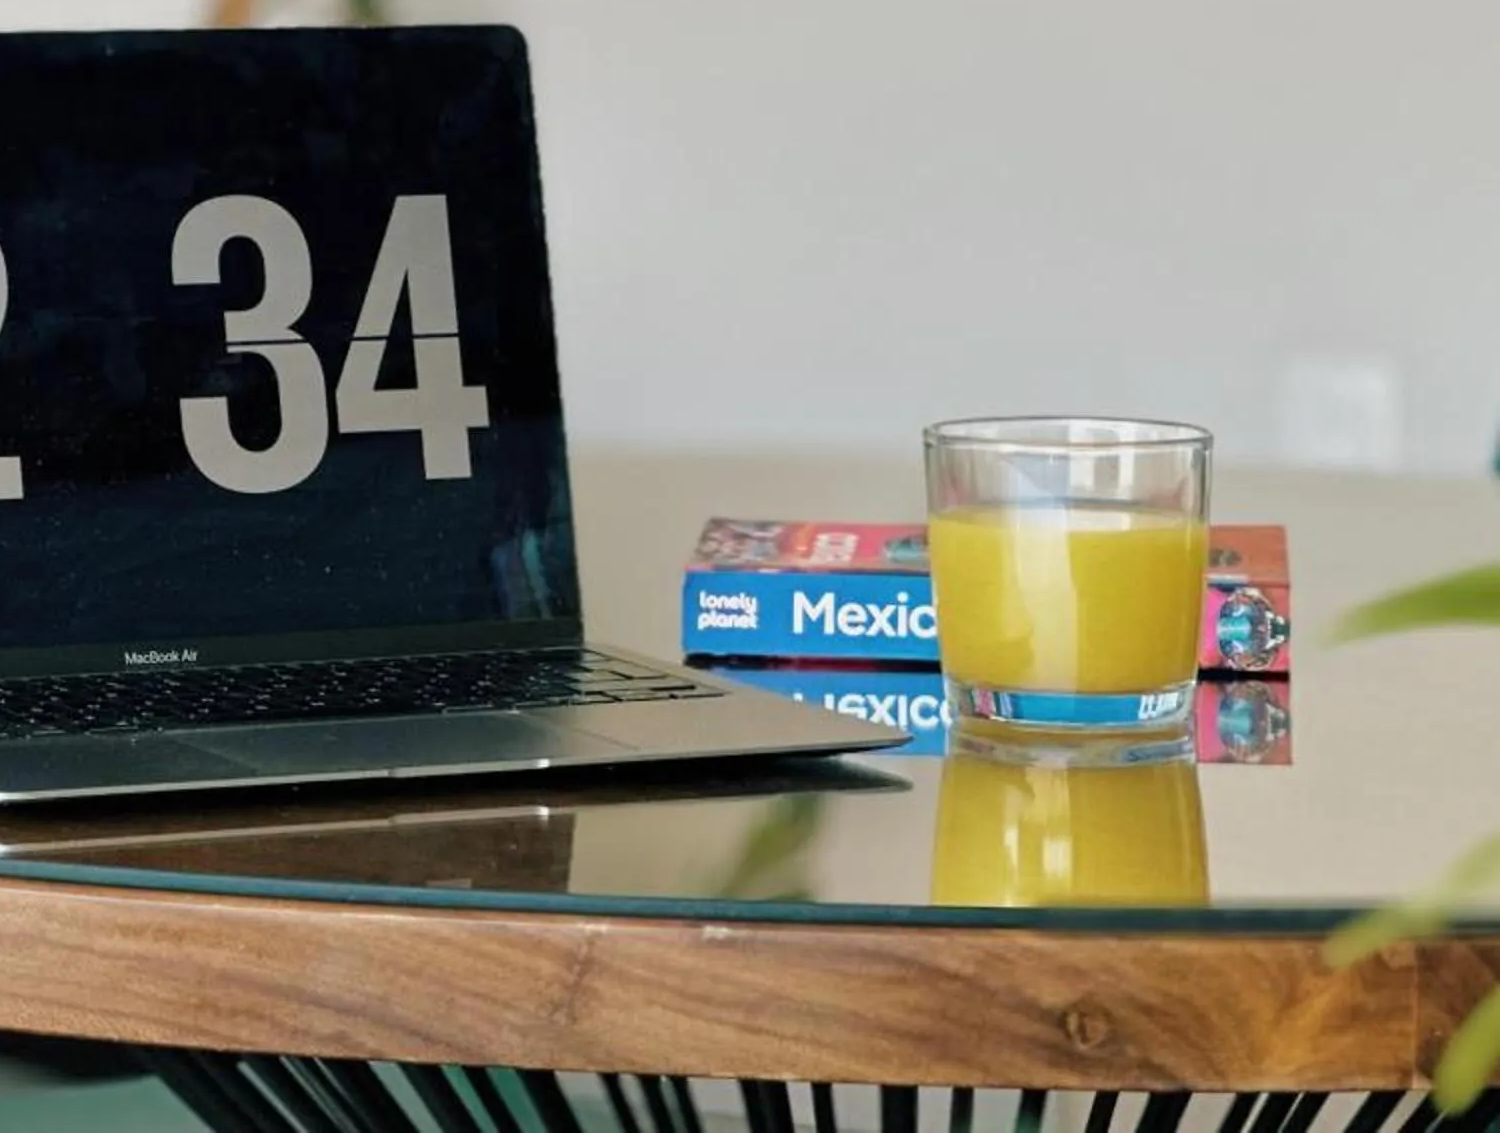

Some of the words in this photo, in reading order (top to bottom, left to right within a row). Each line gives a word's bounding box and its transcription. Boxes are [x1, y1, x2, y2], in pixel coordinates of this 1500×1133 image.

[171, 194, 490, 494] 34
[699, 590, 757, 614] lonely
[697, 611, 758, 630] planet
[793, 591, 938, 639] Mexic
[124, 650, 180, 665] MacBook
[181, 648, 198, 662] Air
